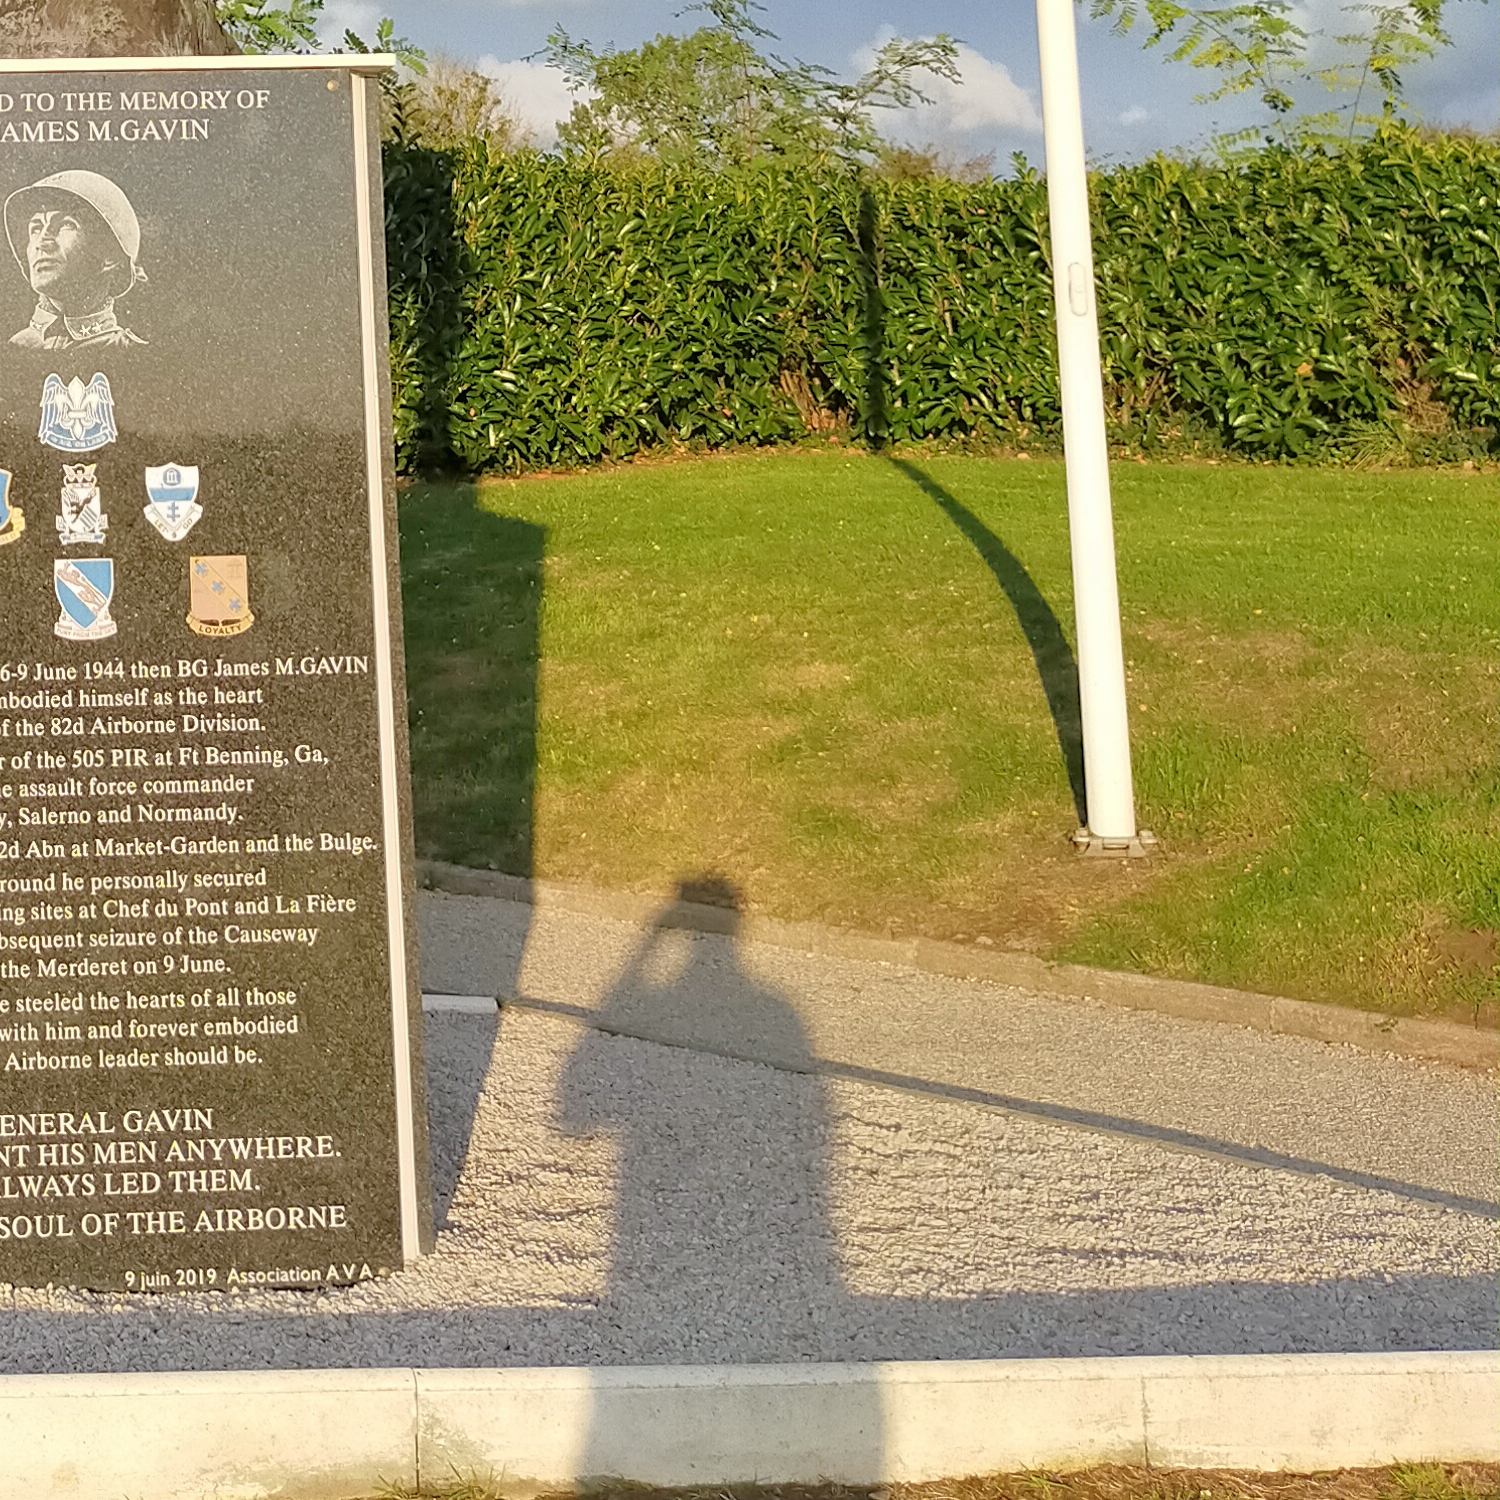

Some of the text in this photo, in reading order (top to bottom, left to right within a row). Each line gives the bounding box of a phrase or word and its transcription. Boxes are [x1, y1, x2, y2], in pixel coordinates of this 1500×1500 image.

[20, 92, 55, 112] TO
[60, 92, 113, 112] THE
[120, 90, 231, 111] MEMORY
[236, 89, 271, 109] OF
[88, 118, 209, 142] M.GAVIN
[199, 624, 242, 635] LOYALTY
[0, 662, 28, 682] 6-9
[33, 663, 77, 681] June
[84, 661, 125, 680] 1944
[130, 660, 172, 679] then
[177, 658, 208, 678] BG
[213, 658, 270, 677] James
[275, 655, 368, 676] M.GAVIN
[79, 687, 149, 708] himself
[153, 691, 173, 706] as
[178, 686, 208, 706] the
[214, 686, 264, 705] heart
[15, 718, 45, 737] the
[50, 717, 85, 736] 82d
[90, 716, 176, 735] Airborne
[182, 712, 266, 734] Division.
[10, 750, 32, 770] of
[36, 750, 66, 769] the
[72, 749, 105, 769] 505
[111, 748, 149, 767] PIR
[154, 750, 173, 767] at
[178, 747, 199, 766] Ft
[205, 745, 289, 769] Benning,
[294, 744, 329, 765] Ga,
[19, 777, 83, 798] assault
[89, 776, 137, 796] force
[142, 774, 255, 795] commander
[18, 806, 91, 826] Salerno
[97, 804, 132, 824] and
[137, 802, 244, 826] Normandy.
[25, 840, 66, 859] Abn
[71, 841, 89, 858] at
[95, 835, 240, 857] Market-Garden
[245, 834, 280, 854] and
[285, 833, 314, 853] the
[319, 832, 378, 856] Bulge.
[62, 872, 84, 891] he
[90, 869, 188, 896] personally
[193, 865, 267, 888] secured
[30, 901, 74, 921] sites
[78, 903, 97, 920] at
[102, 898, 150, 919] Chef
[154, 898, 179, 918] du
[185, 897, 229, 917] Pont
[234, 895, 270, 915] and
[275, 895, 301, 914] La
[306, 894, 357, 914] Fière
[89, 929, 157, 948] seizure
[162, 926, 183, 946] of
[188, 926, 218, 945] the
[224, 925, 319, 947] Causeway
[0, 959, 31, 979] the
[37, 957, 128, 978] Merderet
[133, 960, 158, 975] on
[163, 955, 175, 974] 9
[179, 954, 232, 974] June.
[15, 991, 84, 1015] steeled
[90, 991, 120, 1011] the
[126, 990, 186, 1010] hearts
[190, 988, 212, 1008] of
[216, 987, 240, 1007] all
[245, 987, 297, 1006] those
[45, 1021, 82, 1041] him
[87, 1019, 123, 1040] and
[129, 1018, 199, 1039] forever
[203, 1014, 299, 1037] embodied
[4, 1050, 92, 1072] Airborne
[98, 1048, 160, 1069] leader
[164, 1045, 229, 1067] should
[234, 1045, 263, 1065] be.
[123, 1108, 213, 1133] GAVIN
[38, 1143, 85, 1167] HIS
[93, 1140, 157, 1165] MEN
[165, 1135, 342, 1163] ANYWHERE.
[104, 1171, 161, 1196] LED
[168, 1168, 261, 1193] THEM.
[81, 1212, 120, 1237] OF
[126, 1210, 186, 1235] THE
[193, 1205, 347, 1233] AIRBORNE
[124, 1270, 136, 1287] 9
[140, 1271, 171, 1291] juin
[175, 1268, 217, 1286] 2019
[227, 1266, 322, 1284] Association
